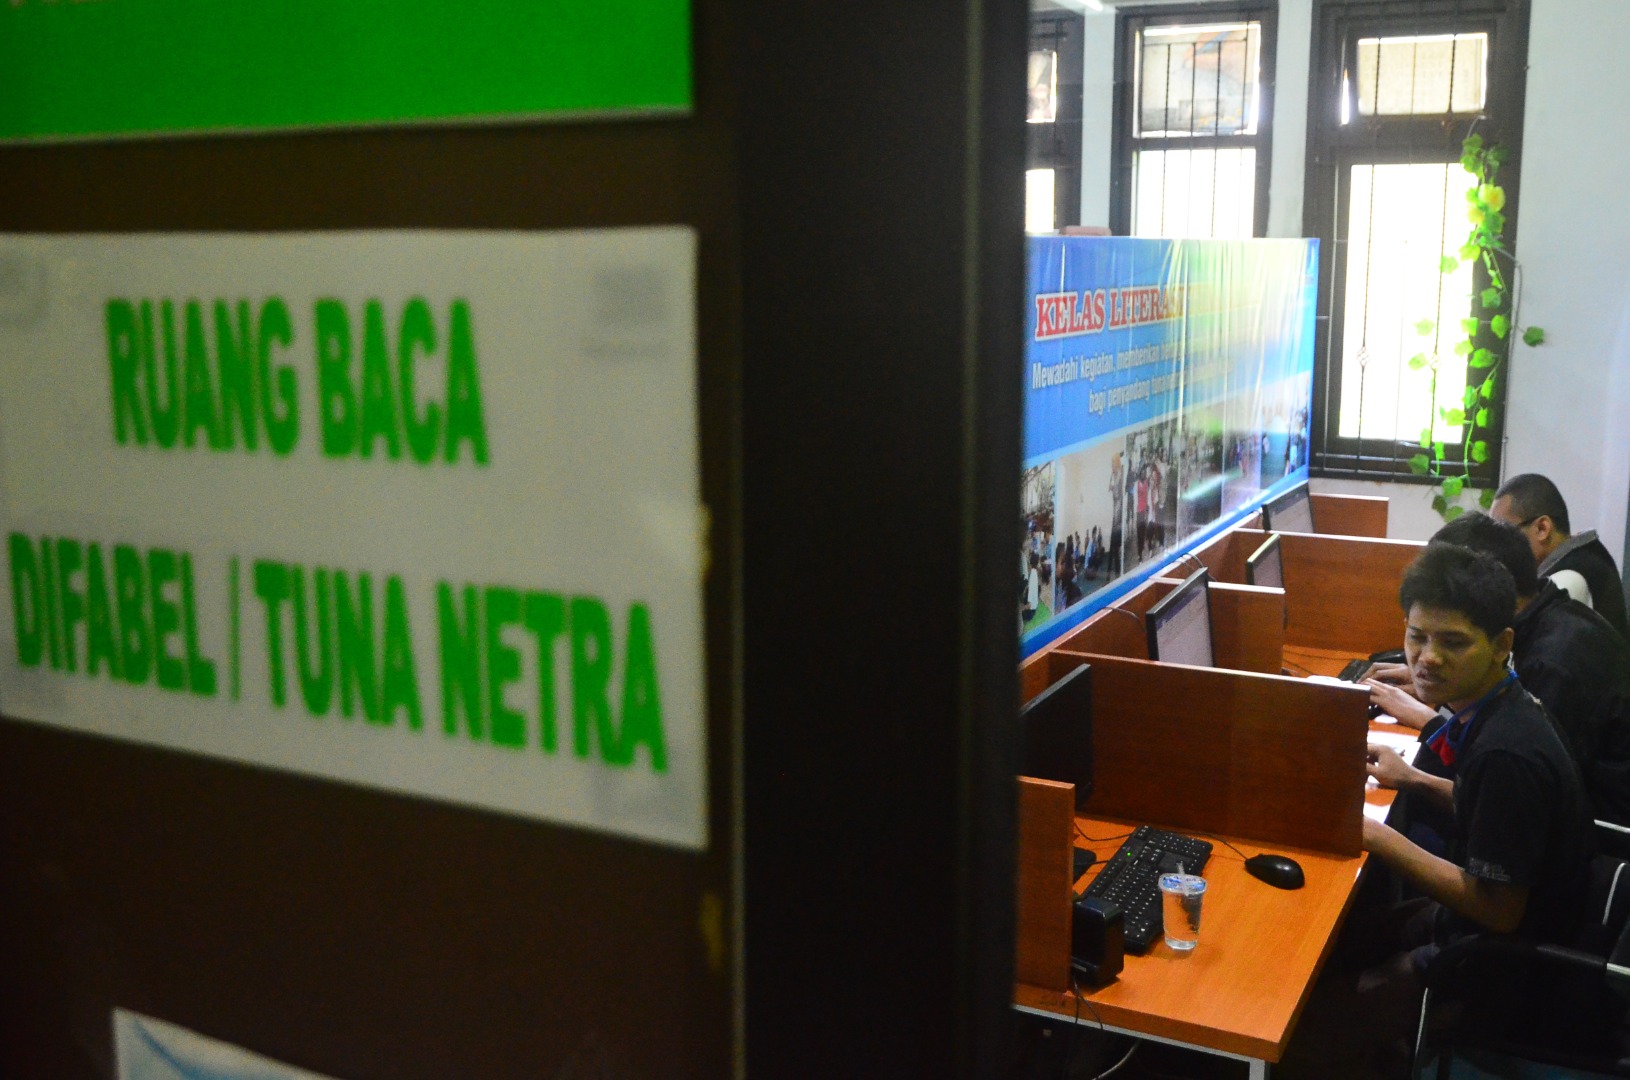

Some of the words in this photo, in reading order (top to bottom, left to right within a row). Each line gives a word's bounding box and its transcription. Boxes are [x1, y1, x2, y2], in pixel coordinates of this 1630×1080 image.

[1036, 291, 1105, 338] KELAS
[105, 297, 299, 458] RUANG
[313, 297, 489, 467] BACA
[1032, 356, 1078, 390] Mewadahi
[1089, 386, 1106, 416] bagi
[9, 533, 217, 697] DIFABEL
[252, 560, 423, 731] TUNA
[435, 581, 668, 774] NETRA
